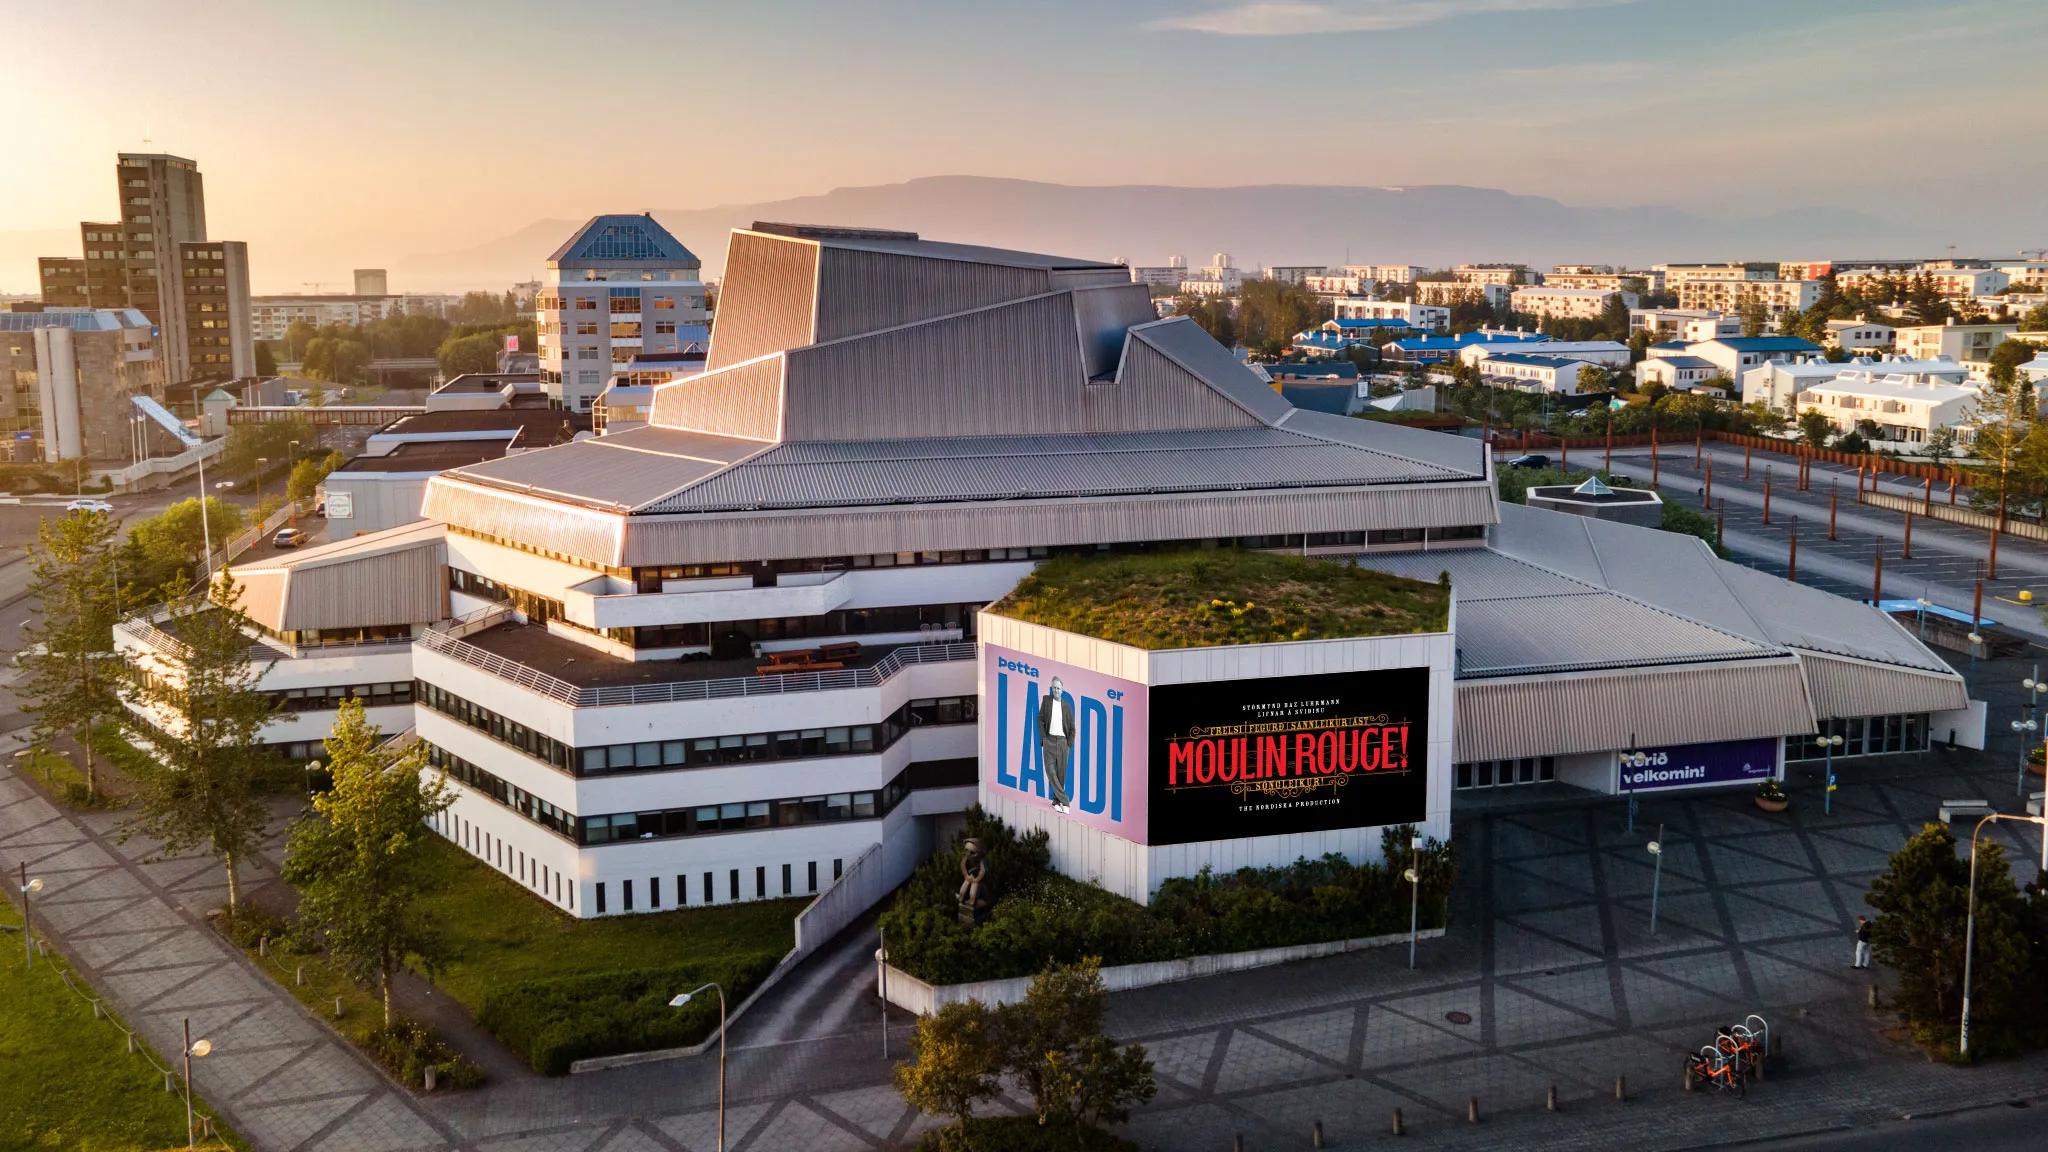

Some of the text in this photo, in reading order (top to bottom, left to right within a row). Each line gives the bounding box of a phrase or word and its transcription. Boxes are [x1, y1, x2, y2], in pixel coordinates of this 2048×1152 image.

[1106, 688, 1124, 701] er
[1300, 698, 1340, 707] LUHRMANN
[1257, 710, 1284, 718] LIFNAR
[1210, 725, 1242, 735] FRELSI
[1291, 718, 1348, 730] SANNLEIKUR
[997, 672, 1124, 822] LADI
[1169, 726, 1409, 785] MOULIN ROUGE!
[1623, 766, 1705, 784] velkomin!
[1255, 802, 1293, 810] NORDISKA
[1295, 798, 1341, 808] PRODUCTION
